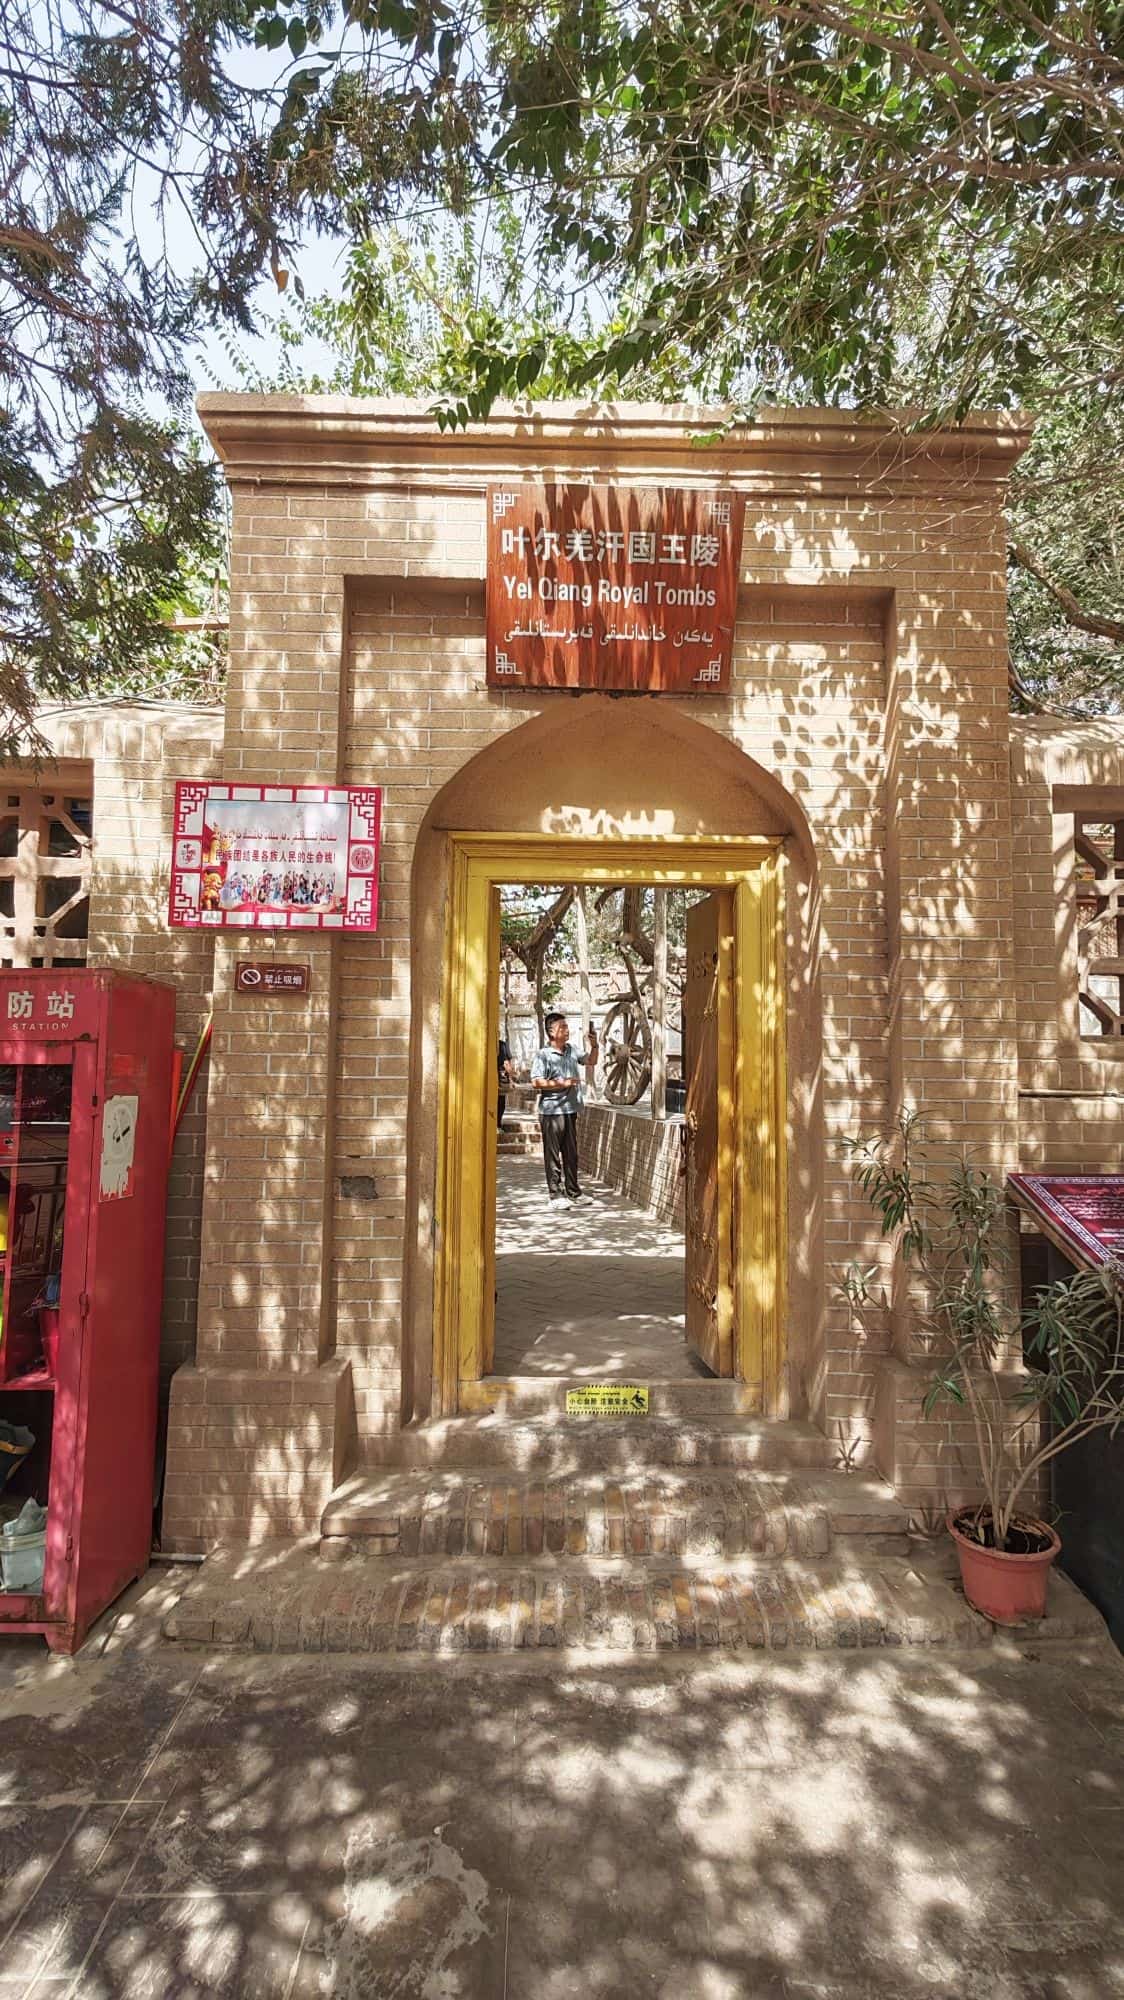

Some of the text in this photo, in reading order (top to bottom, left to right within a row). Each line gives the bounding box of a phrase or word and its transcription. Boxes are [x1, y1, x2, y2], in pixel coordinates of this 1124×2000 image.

[502, 526, 720, 567] 叶尔羌汗国王陵
[538, 576, 592, 607] Qiang
[598, 579, 649, 609] Royal
[654, 581, 716, 607] Tombs
[12, 1022, 69, 1031] STATION
